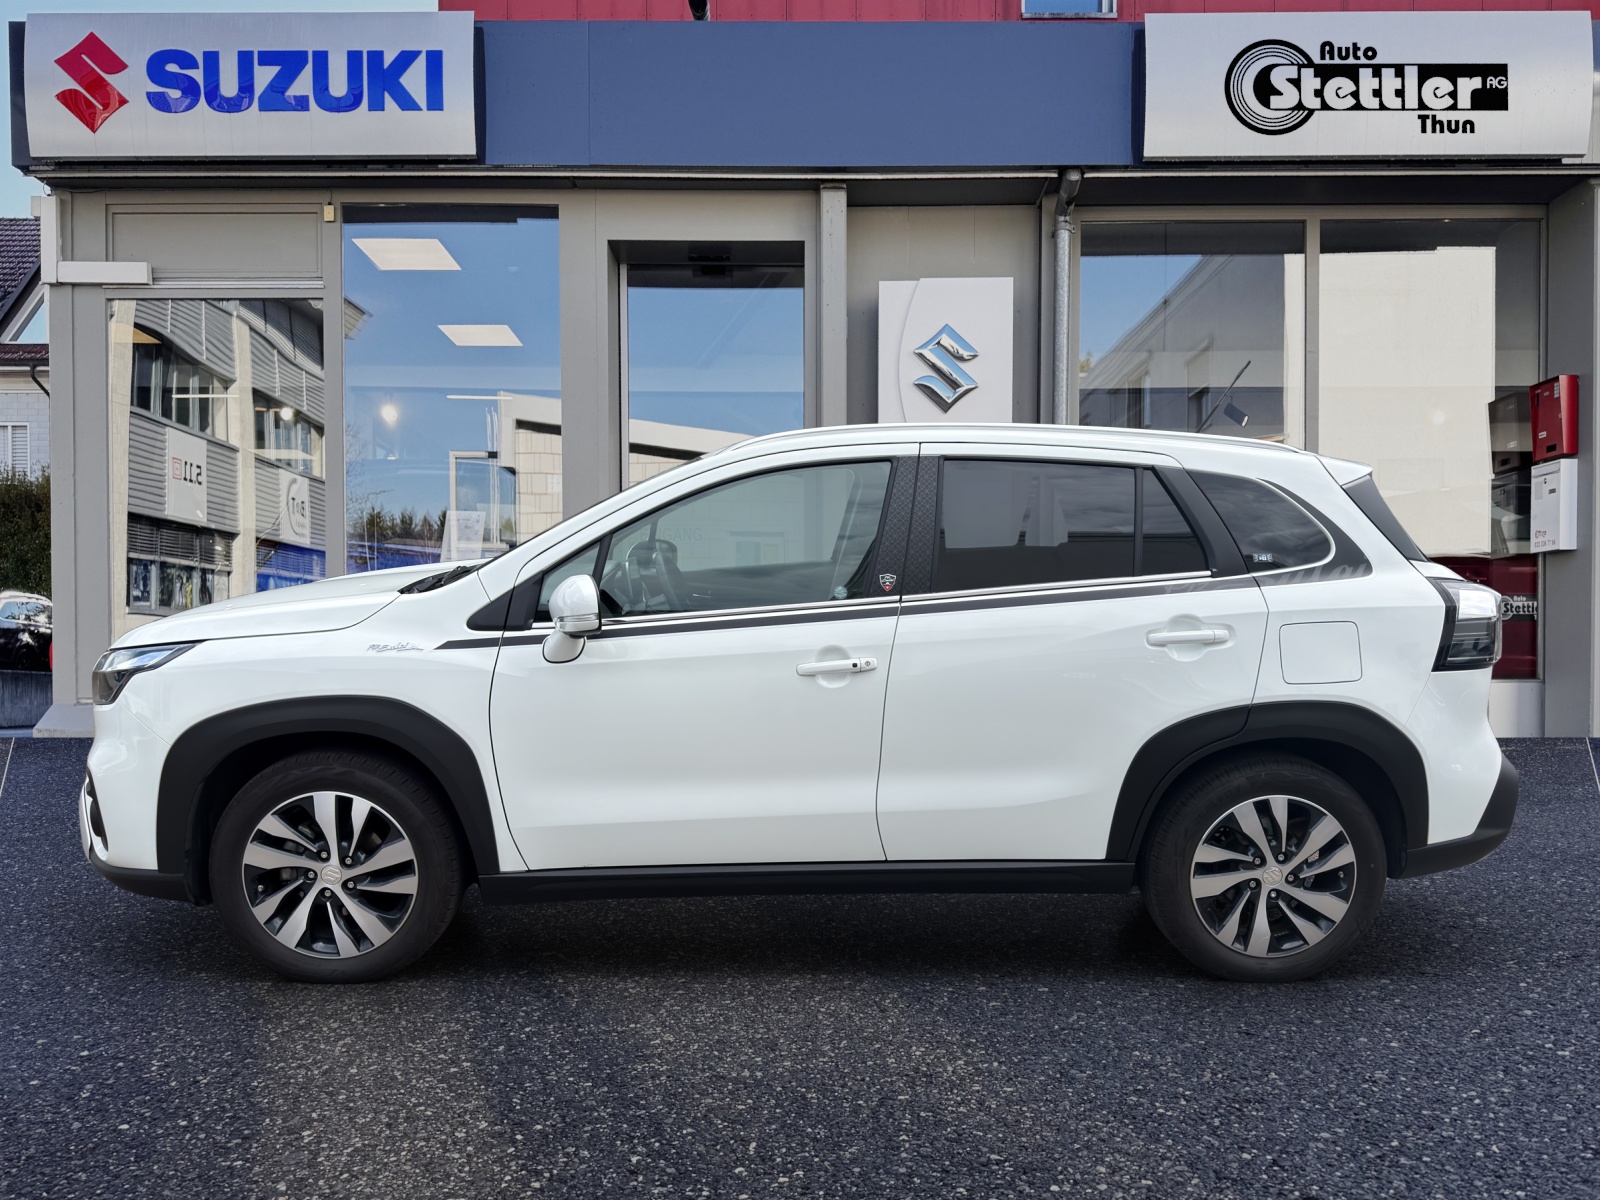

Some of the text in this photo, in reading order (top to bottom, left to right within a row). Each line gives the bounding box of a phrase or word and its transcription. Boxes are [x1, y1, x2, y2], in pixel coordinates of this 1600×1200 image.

[1319, 40, 1378, 61] Auto
[145, 48, 444, 113] SUZUKI
[1269, 63, 1508, 111] Stettler AG
[1417, 114, 1476, 135] Thun
[641, 527, 703, 542] ENGANG
